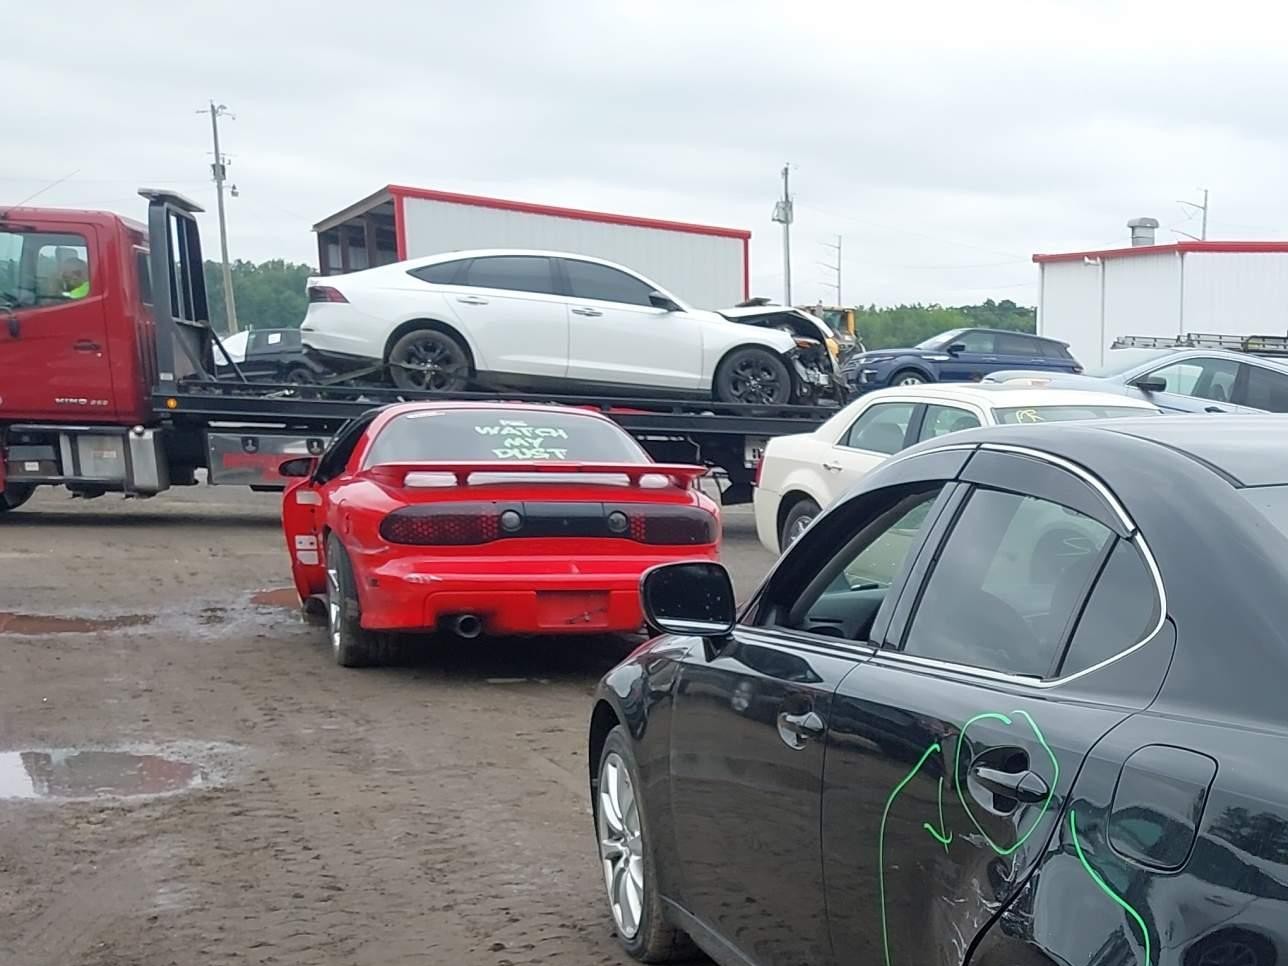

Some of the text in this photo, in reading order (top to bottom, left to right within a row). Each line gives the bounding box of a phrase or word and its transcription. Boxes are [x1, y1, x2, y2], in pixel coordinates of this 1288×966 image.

[475, 426, 568, 439] WATCH
[503, 437, 544, 448] MY
[492, 448, 567, 459] DUST
